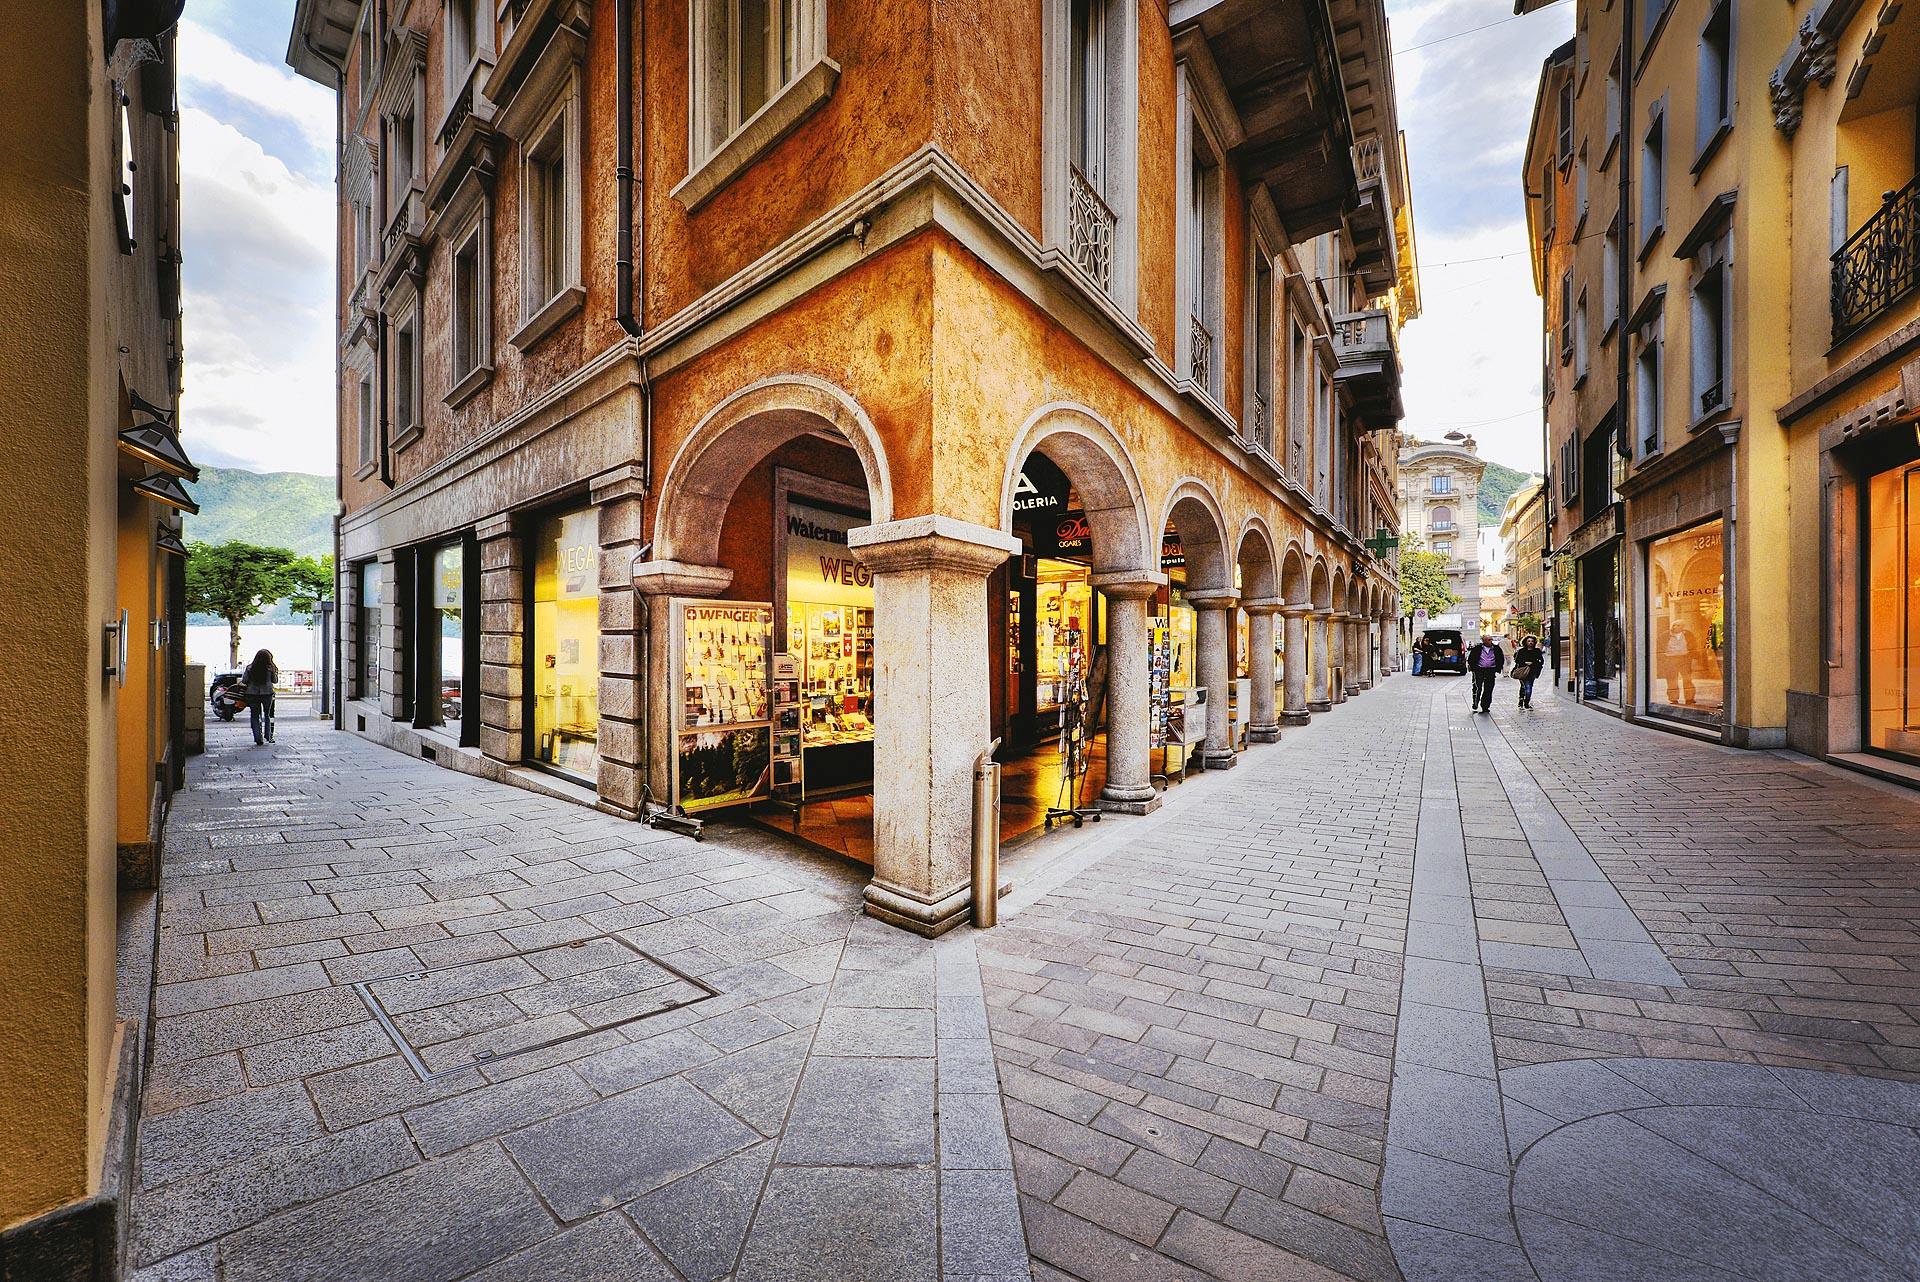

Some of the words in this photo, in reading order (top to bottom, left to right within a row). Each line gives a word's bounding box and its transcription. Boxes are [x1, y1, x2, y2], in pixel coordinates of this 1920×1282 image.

[1013, 495, 1058, 511] OLERIA
[557, 543, 596, 573] WEGA
[1668, 587, 1719, 598] VERSACE
[699, 609, 758, 623] WENGER
